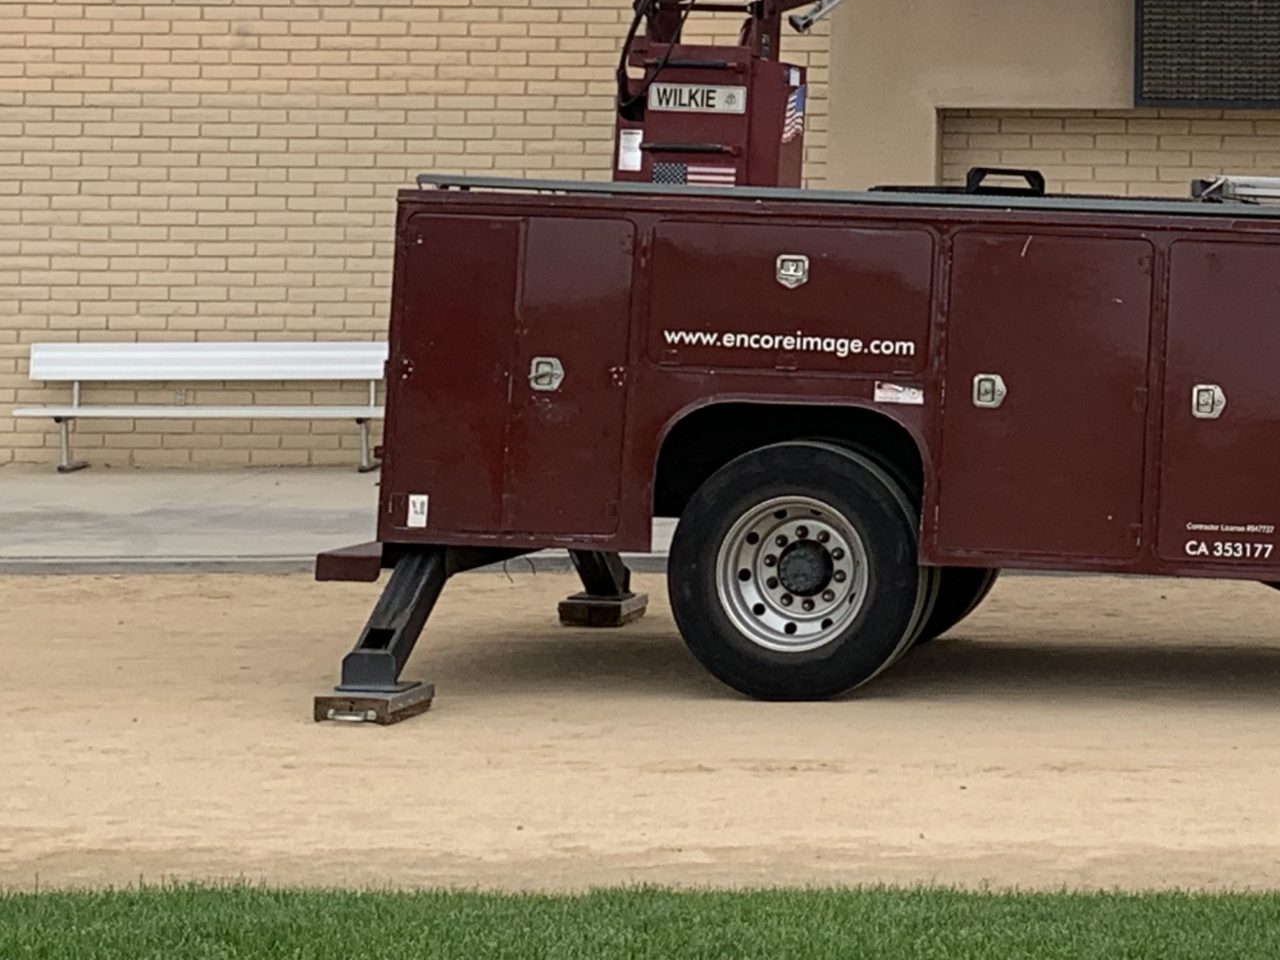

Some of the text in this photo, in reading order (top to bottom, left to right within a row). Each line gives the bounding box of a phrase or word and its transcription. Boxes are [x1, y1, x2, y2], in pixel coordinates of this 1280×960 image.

[657, 87, 717, 108] WILKIE
[664, 329, 915, 357] www.encoreimage.com
[1185, 540, 1274, 558] CA 353177
